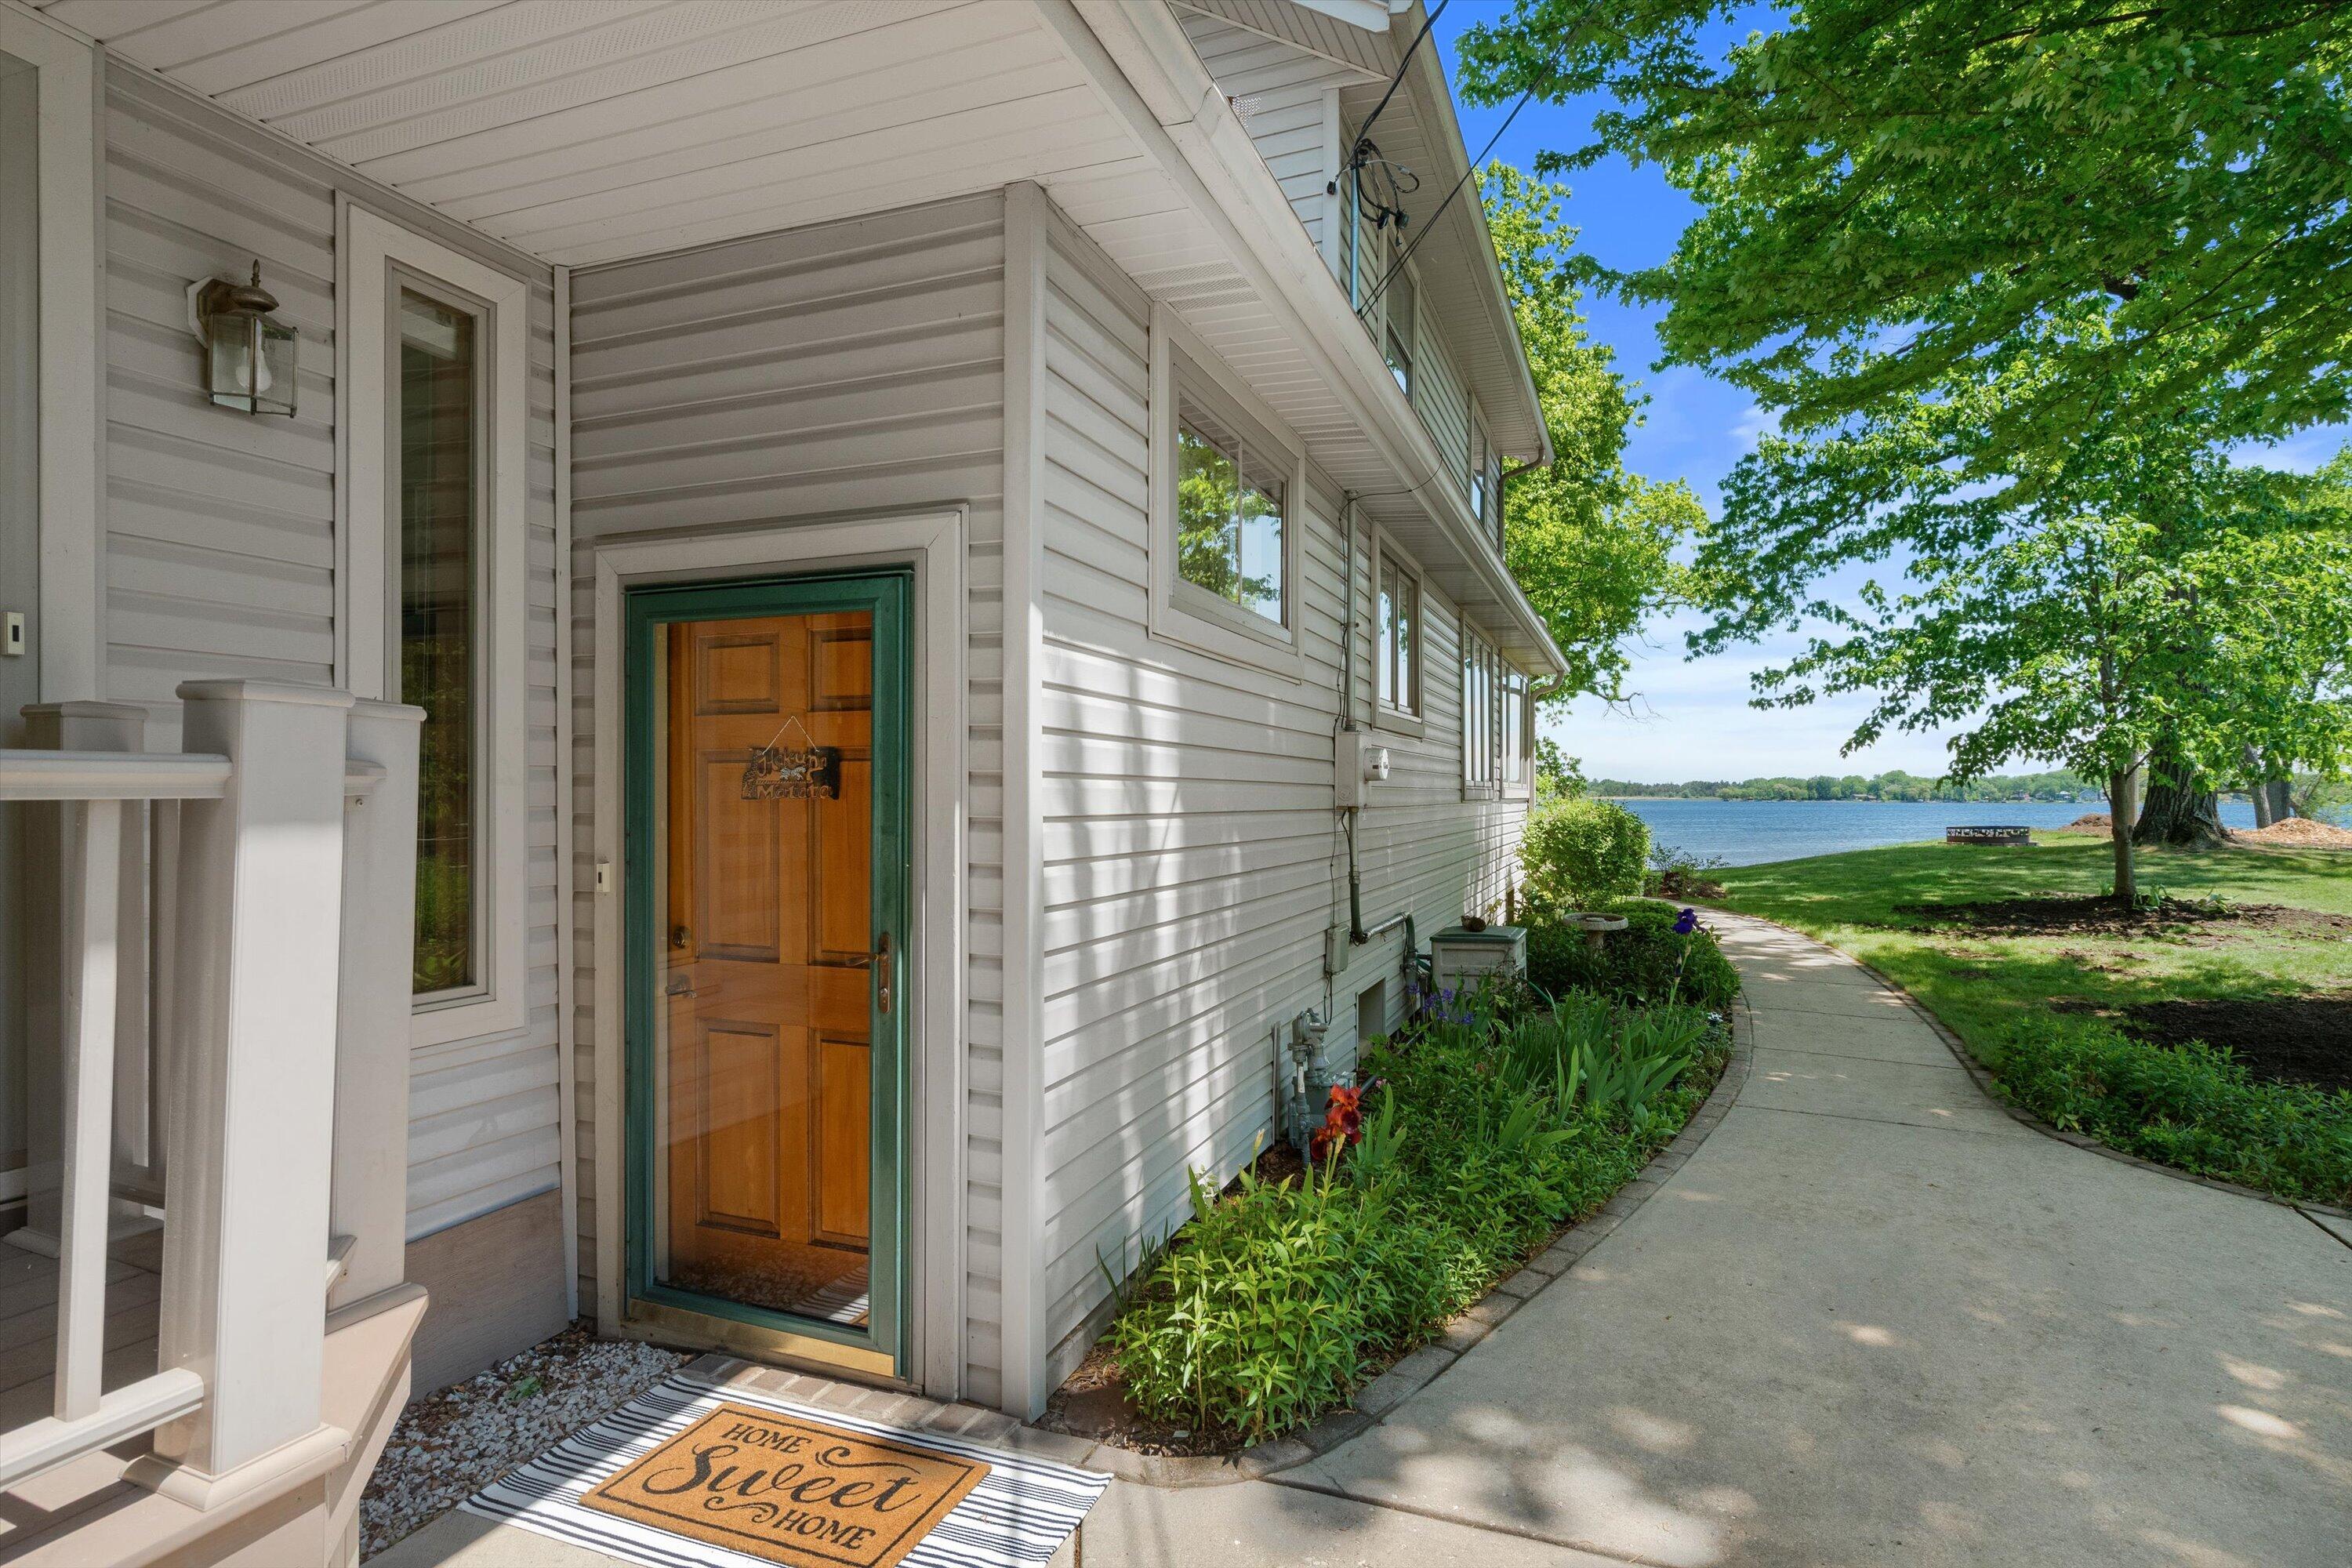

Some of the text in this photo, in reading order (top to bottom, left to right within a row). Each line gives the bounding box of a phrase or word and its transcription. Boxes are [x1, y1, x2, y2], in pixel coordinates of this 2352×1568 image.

[757, 749, 826, 777] Hakuna
[757, 785, 832, 799] Matata
[721, 1423, 811, 1454] HOME
[642, 1443, 921, 1512] Sweet
[772, 1508, 877, 1549] HOME
